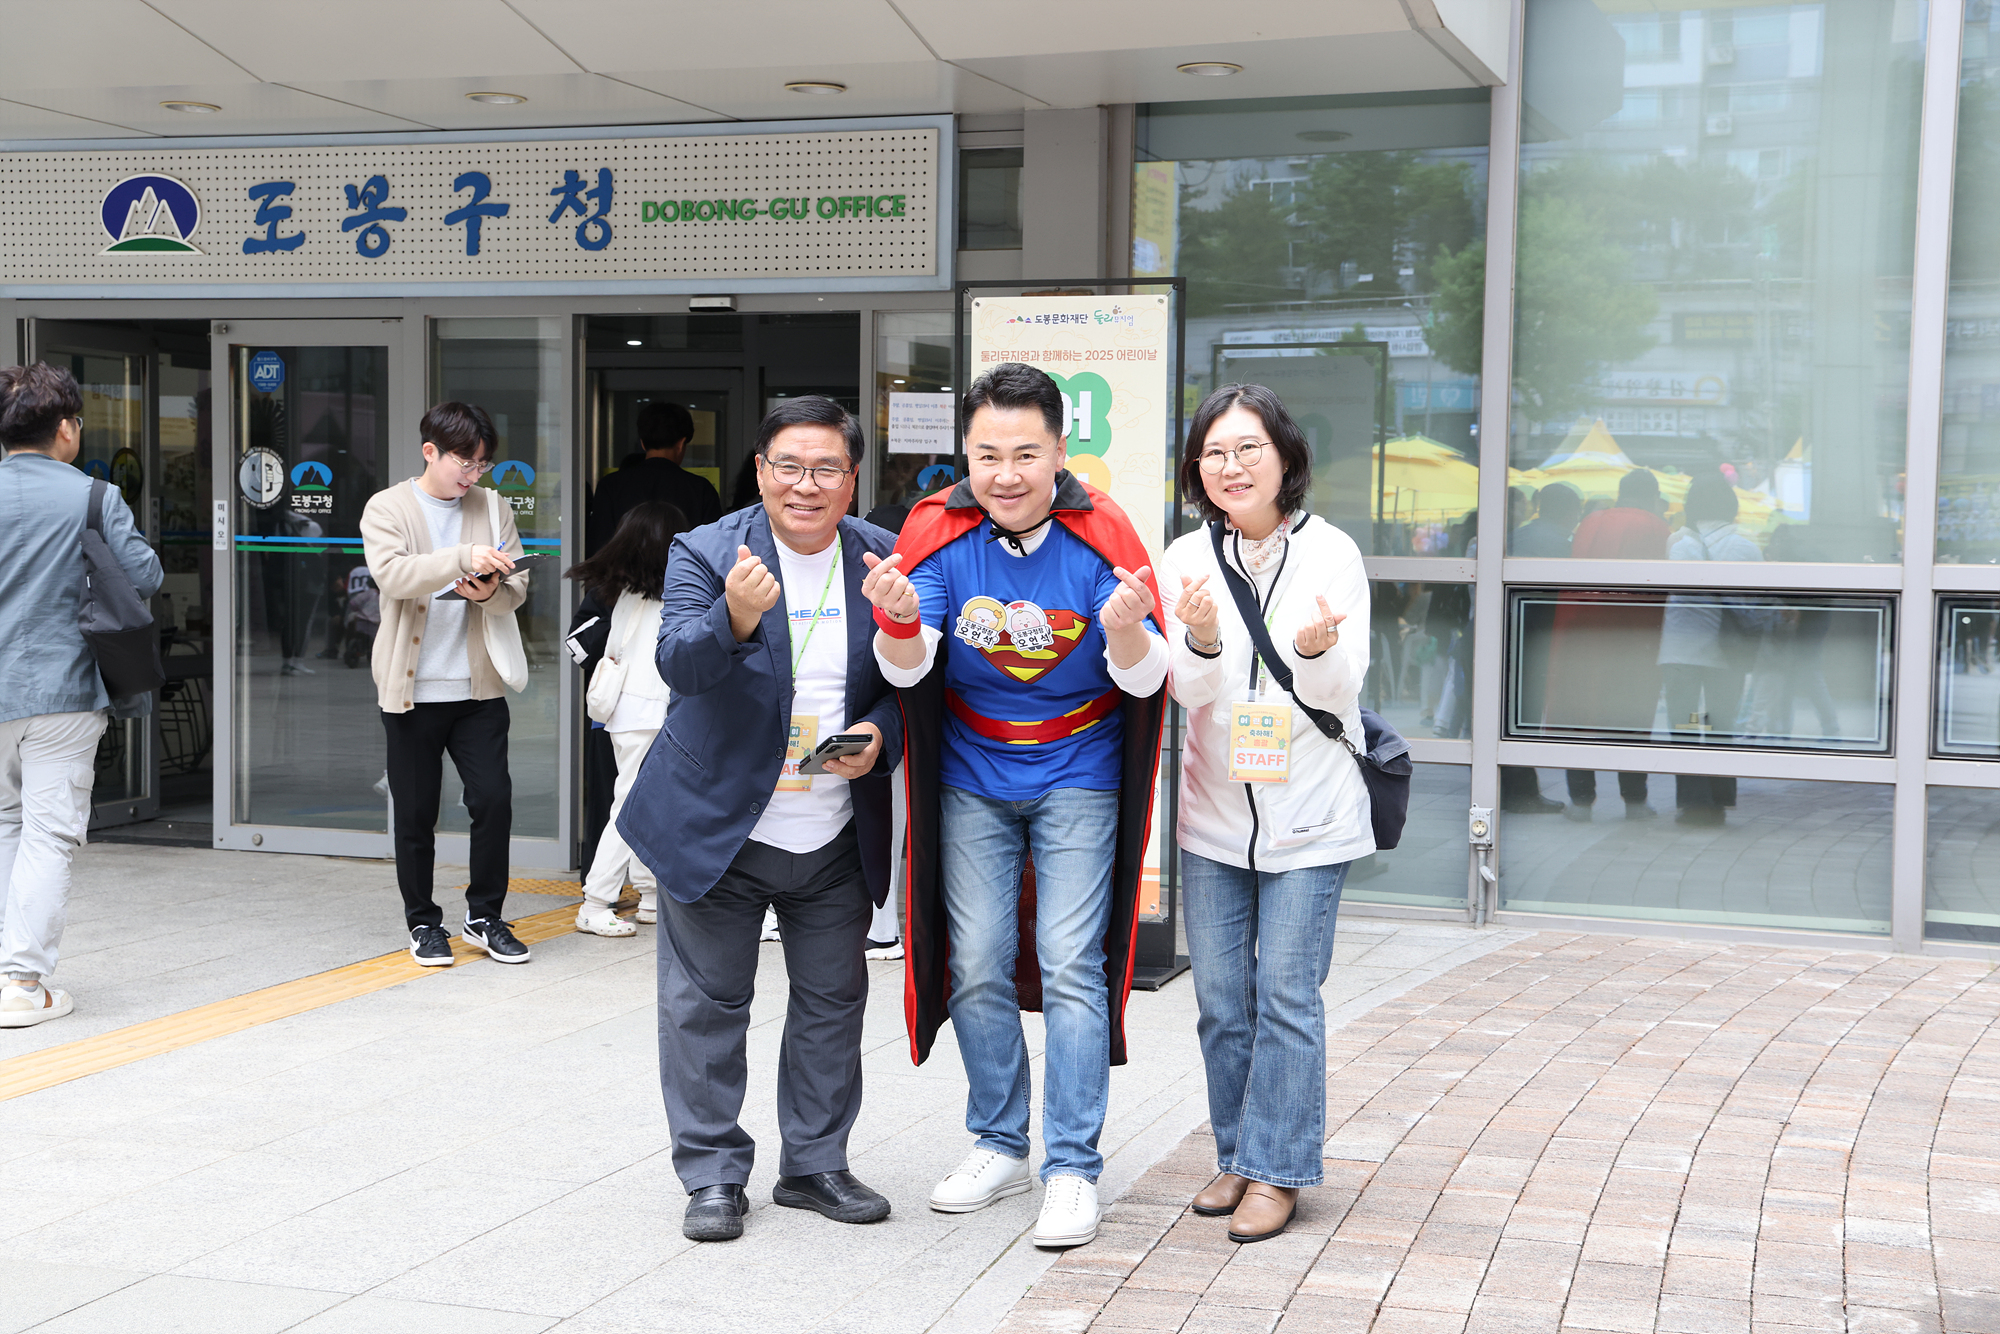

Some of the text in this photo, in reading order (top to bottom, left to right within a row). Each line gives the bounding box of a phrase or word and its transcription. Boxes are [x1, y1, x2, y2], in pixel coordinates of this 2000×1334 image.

[240, 167, 614, 258] 도봉구청
[640, 194, 907, 225] DOBONG-GU OFFICE
[1034, 313, 1089, 325] 도봉문화재단
[980, 349, 1158, 362] 둘리뮤지엄과 함께하는 2025 어린이날
[254, 364, 280, 379] ADT
[290, 495, 333, 508] 도봉구청
[503, 496, 535, 510] 봉구청
[217, 503, 226, 538] 미시오
[789, 608, 840, 618] HEAD
[1240, 716, 1283, 726] 어린이날
[791, 728, 810, 736] 이날
[1250, 729, 1273, 738] 축하해!
[1236, 752, 1286, 766] STAFF
